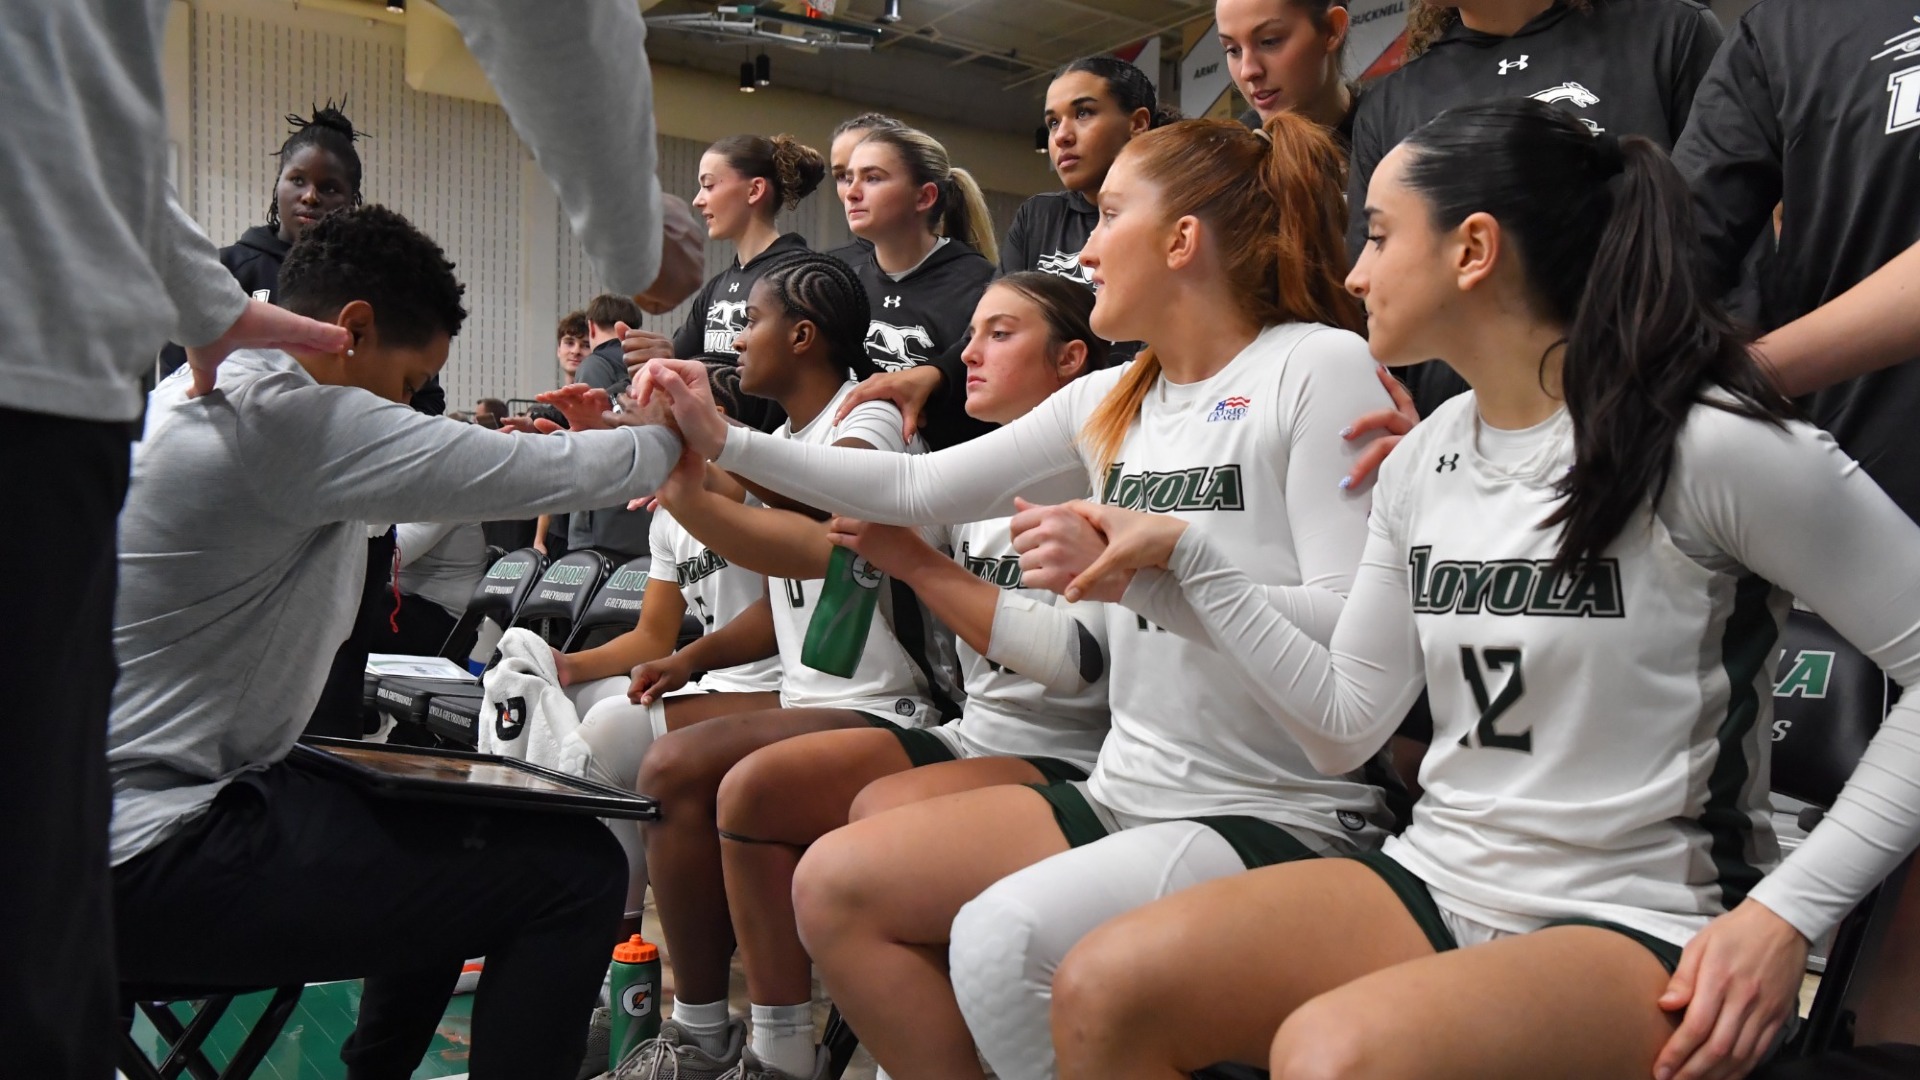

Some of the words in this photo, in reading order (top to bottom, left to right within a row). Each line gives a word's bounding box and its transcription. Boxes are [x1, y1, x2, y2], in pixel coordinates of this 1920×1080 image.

[1351, 1, 1404, 27] BUCKNELL
[1194, 63, 1219, 79] ARMY
[1100, 462, 1245, 513] LOYOLA
[606, 564, 649, 592] LOYO
[1409, 544, 1626, 619] LOYOLA
[540, 589, 575, 602] GREYHOUNDS
[604, 597, 643, 610] GREYHOUN
[1457, 643, 1534, 755] 12
